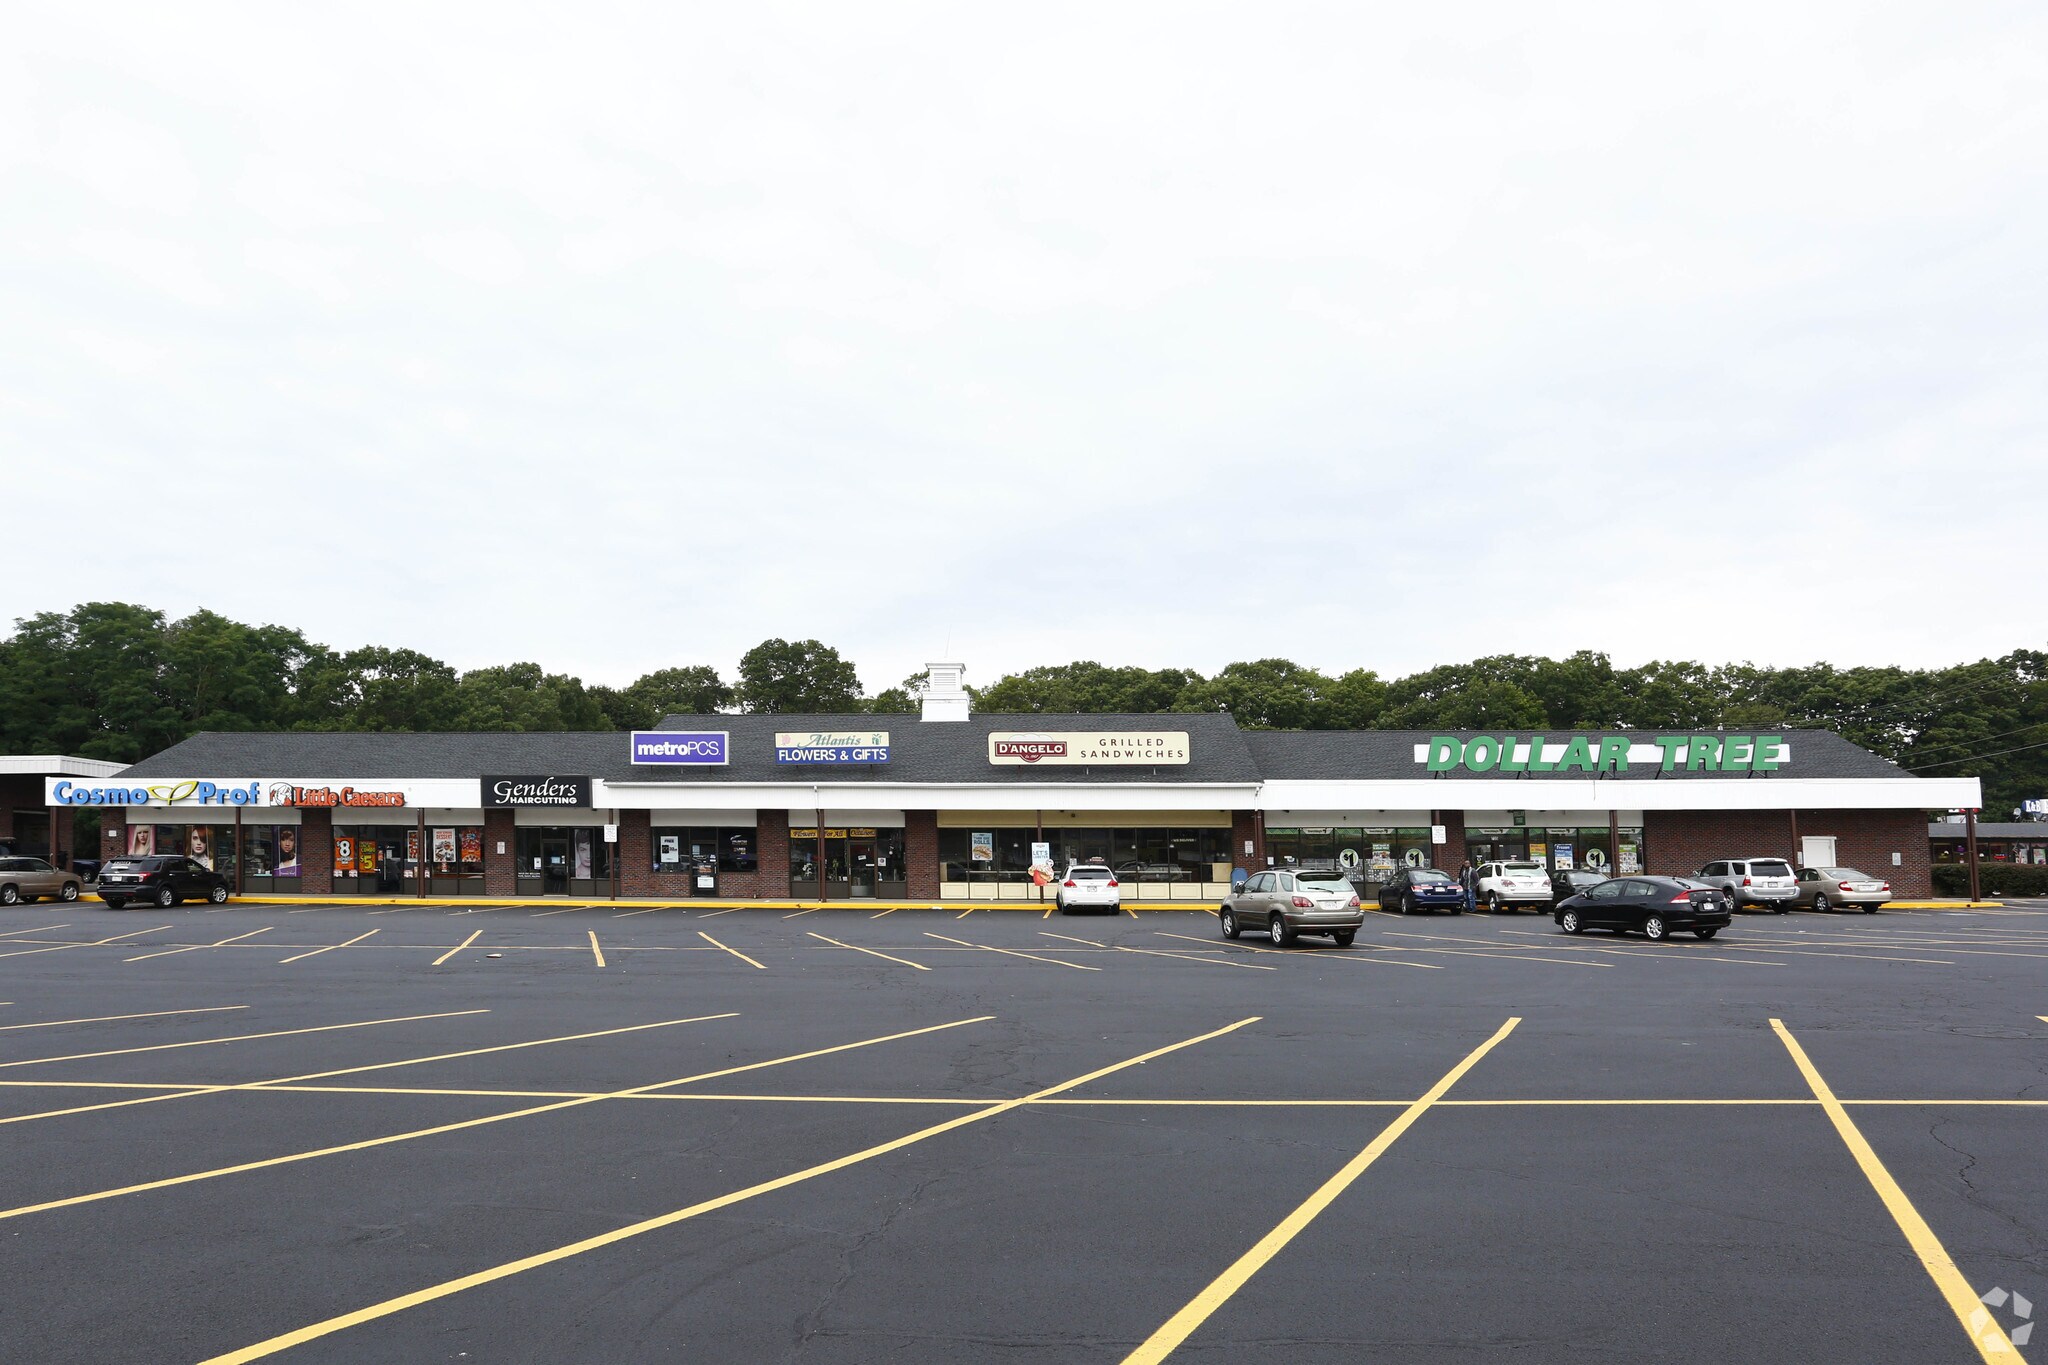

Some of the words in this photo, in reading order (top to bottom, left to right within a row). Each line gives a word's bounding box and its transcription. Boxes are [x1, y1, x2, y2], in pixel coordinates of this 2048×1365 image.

[797, 733, 862, 749] Atlantis
[1099, 738, 1164, 747] GRILLED
[778, 749, 836, 762] FLOWERS
[839, 749, 850, 761] &
[852, 748, 888, 761] GIFTS
[999, 744, 1064, 754] D'ANGELO
[1080, 749, 1184, 759] SANDWICHES
[1426, 736, 1631, 772] DOLLAR
[1656, 735, 1782, 771] TREE
[53, 781, 149, 805] Cosmo
[197, 781, 260, 805] Prof
[294, 786, 339, 807] Little
[340, 787, 405, 808] Caesars
[493, 776, 577, 804] Genders
[510, 796, 578, 805] HAIRCUTTING
[2025, 800, 2041, 813] K&B
[1343, 852, 1354, 867] $1
[1409, 852, 1420, 867] $1
[1589, 852, 1600, 867] $1
